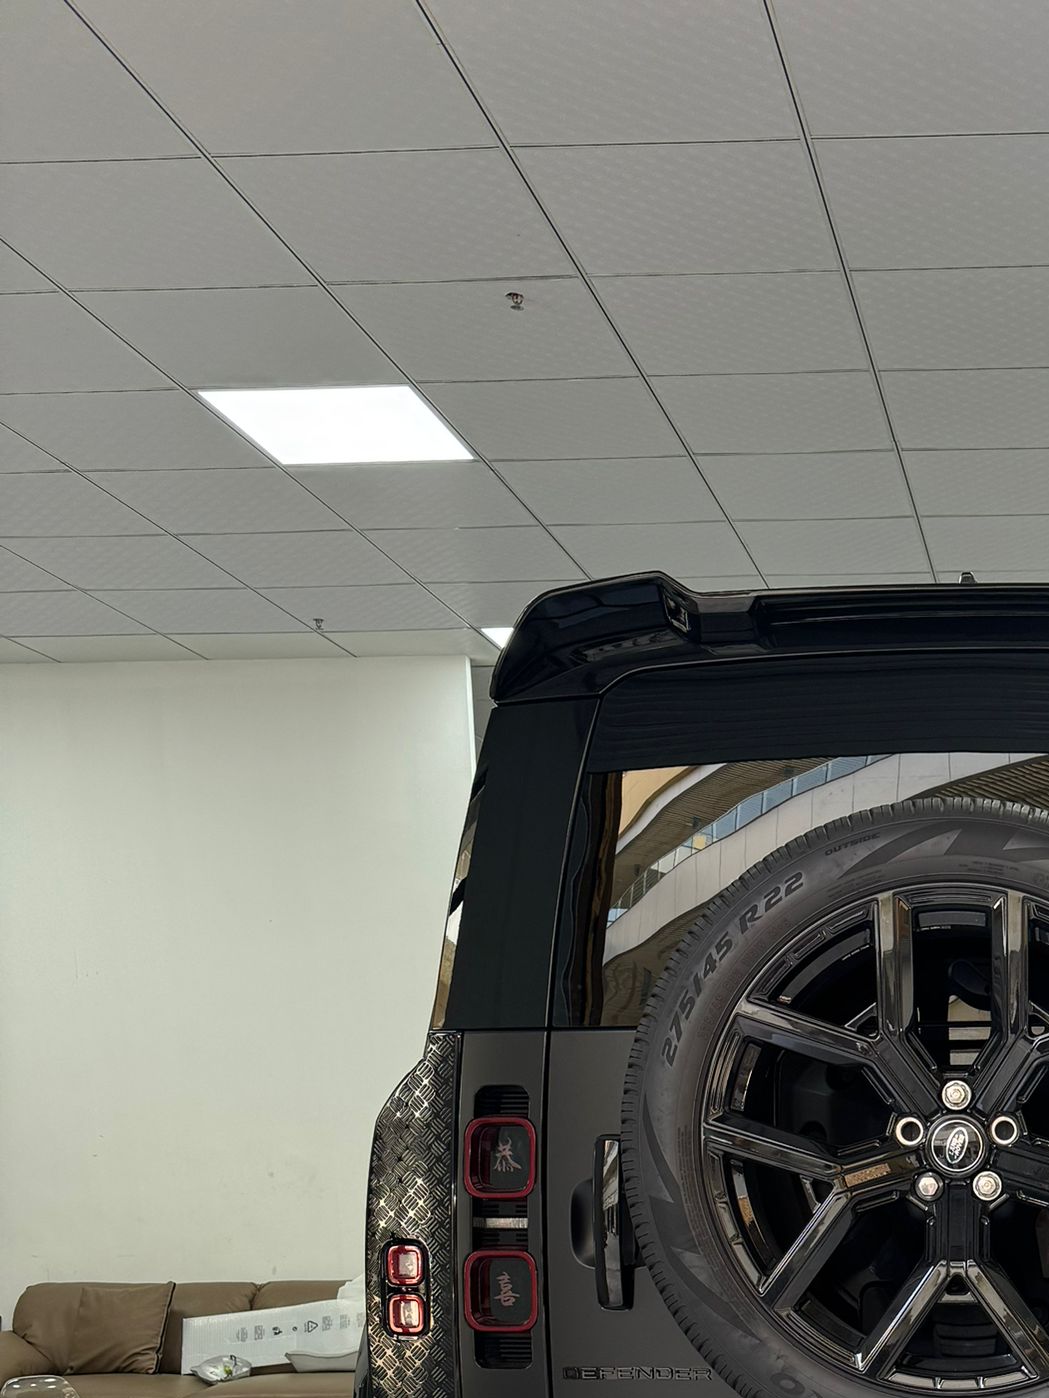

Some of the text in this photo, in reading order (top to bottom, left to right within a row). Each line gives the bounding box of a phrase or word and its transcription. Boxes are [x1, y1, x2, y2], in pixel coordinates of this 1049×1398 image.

[825, 832, 881, 856] OUTSIDE
[662, 931, 734, 1067] 275/45
[739, 871, 804, 934] R22
[563, 1366, 713, 1381] DEFENDER
